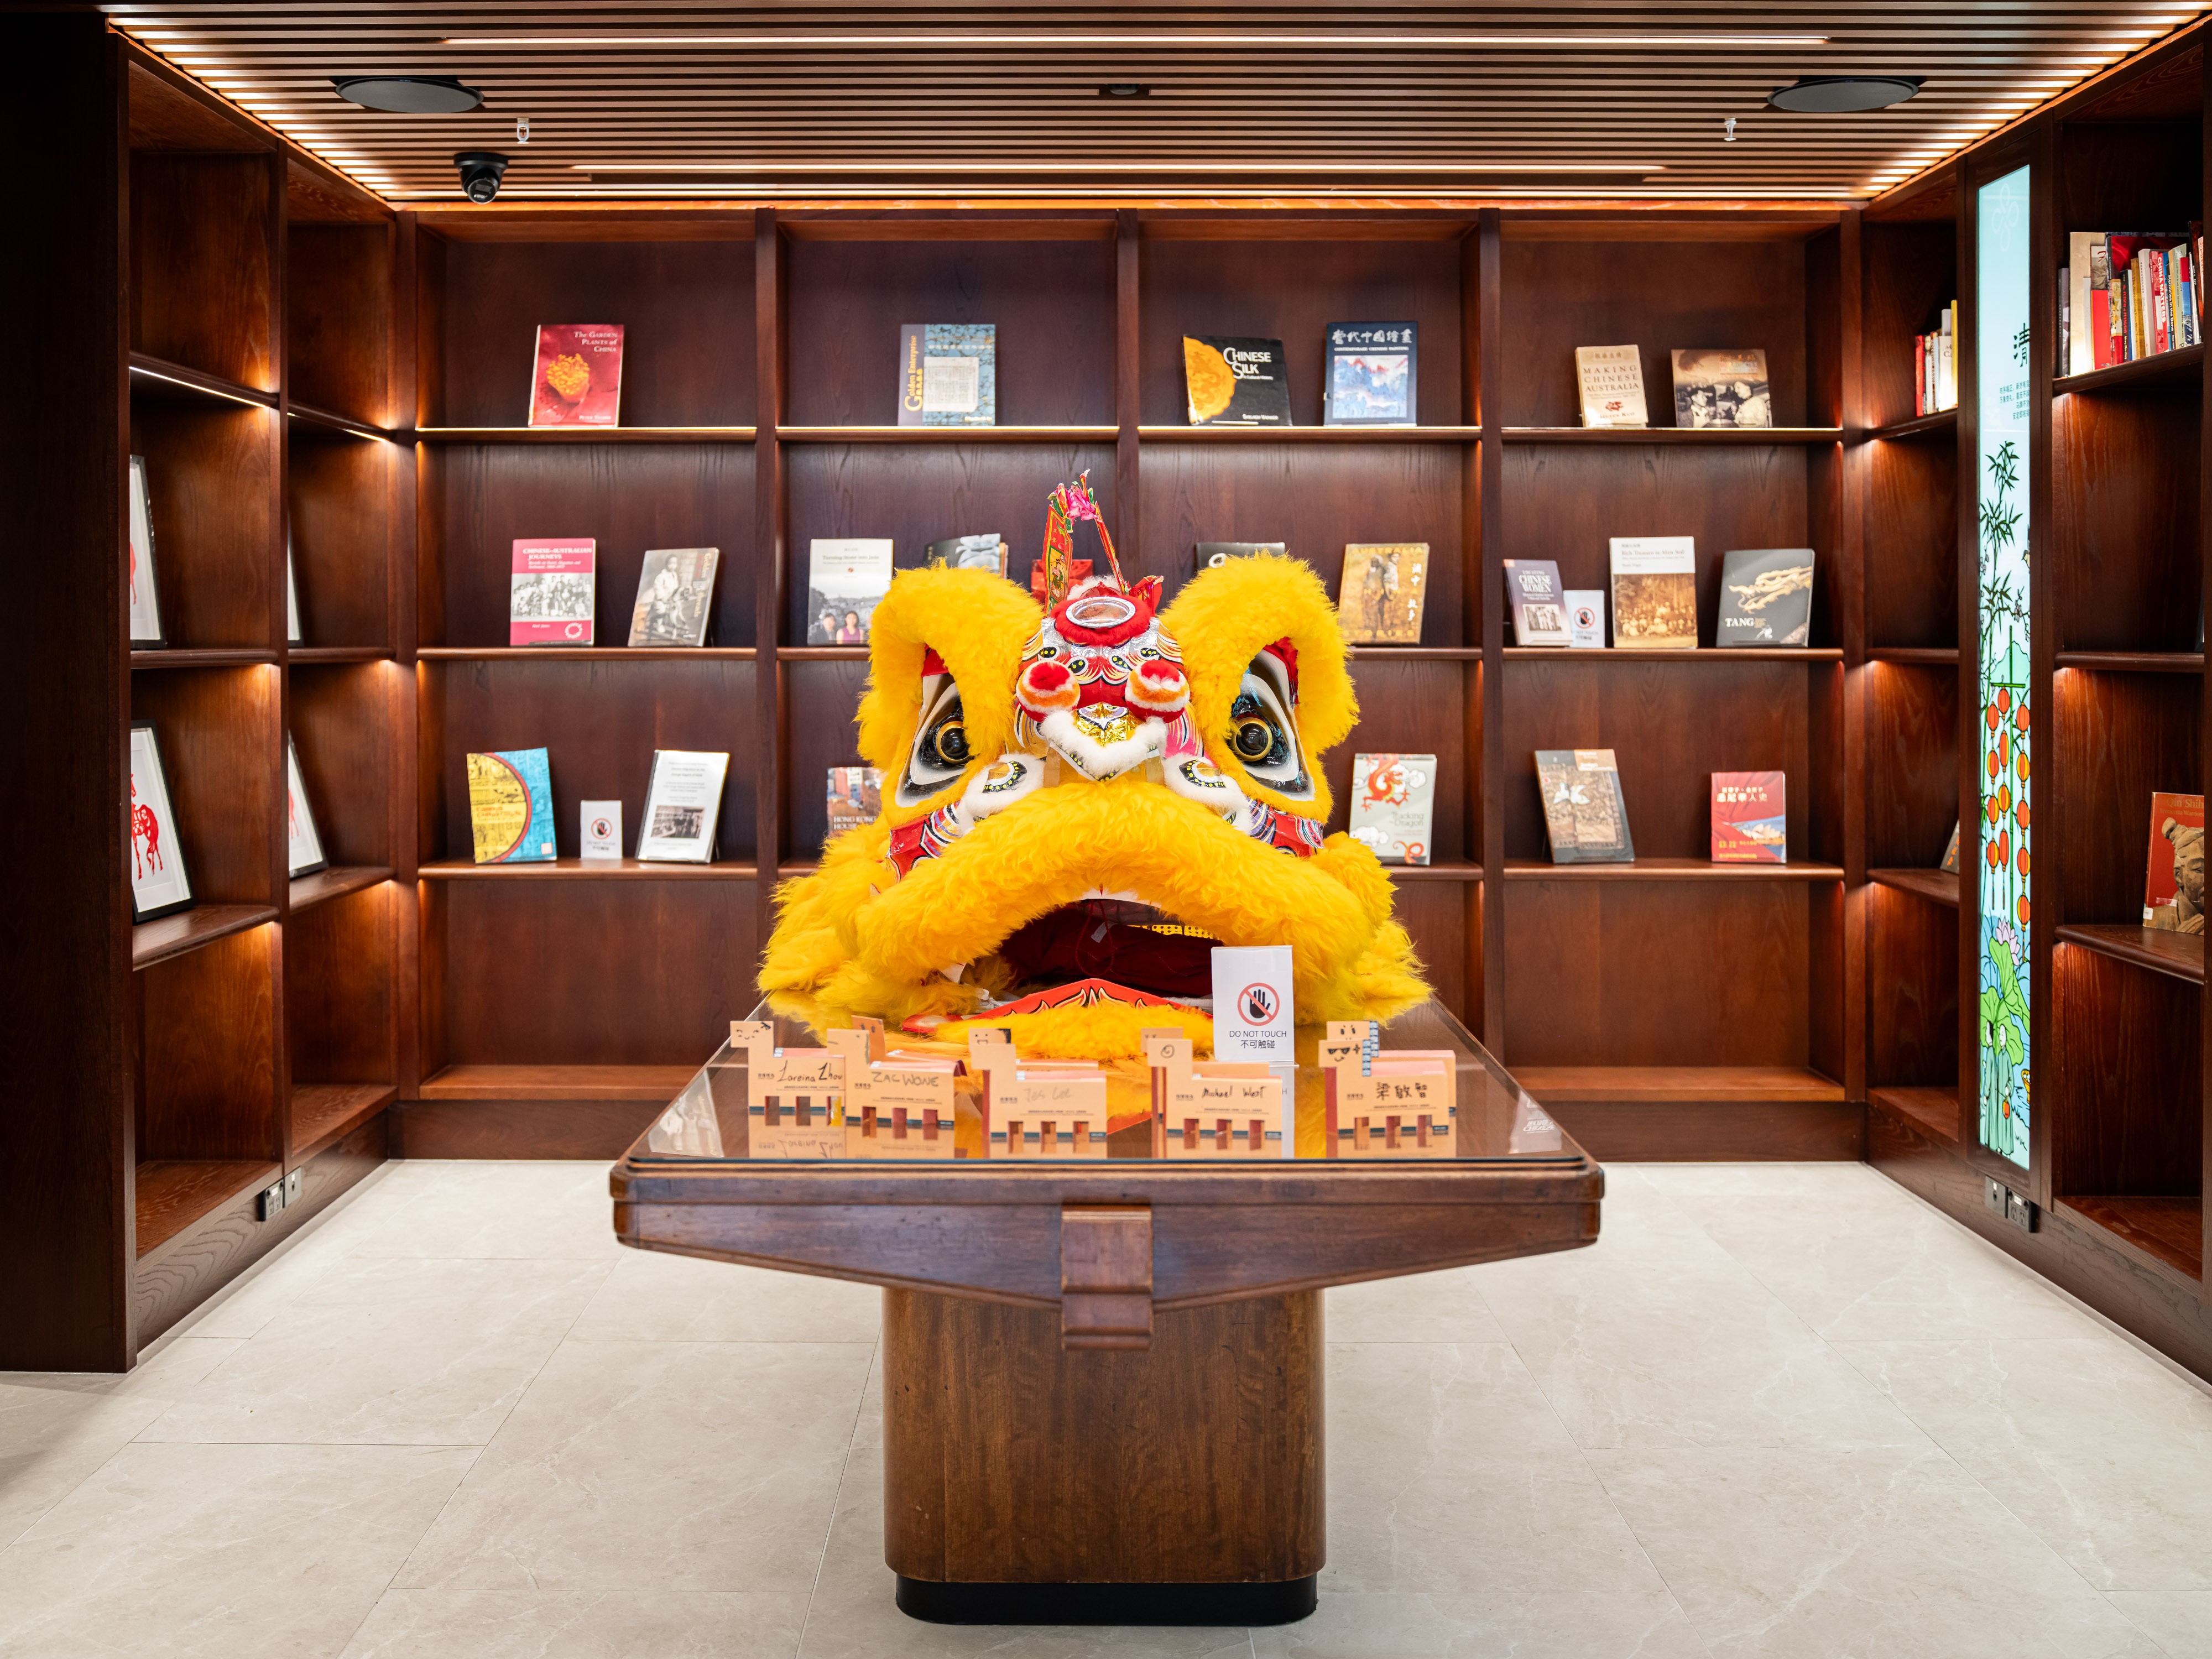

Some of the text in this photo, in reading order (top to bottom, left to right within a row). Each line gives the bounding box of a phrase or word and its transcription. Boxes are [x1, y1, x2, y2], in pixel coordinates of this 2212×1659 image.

[1223, 347, 1271, 364] CHINESE
[1232, 363, 1259, 379] SILK
[1583, 364, 1637, 374] MAKING
[1584, 373, 1638, 384] CHINESE
[1585, 383, 1640, 393] AUSTRALIA
[1725, 618, 1754, 627] TANG
[1240, 1040, 1275, 1049] 不可触碰
[872, 1071, 900, 1083] ZAC
